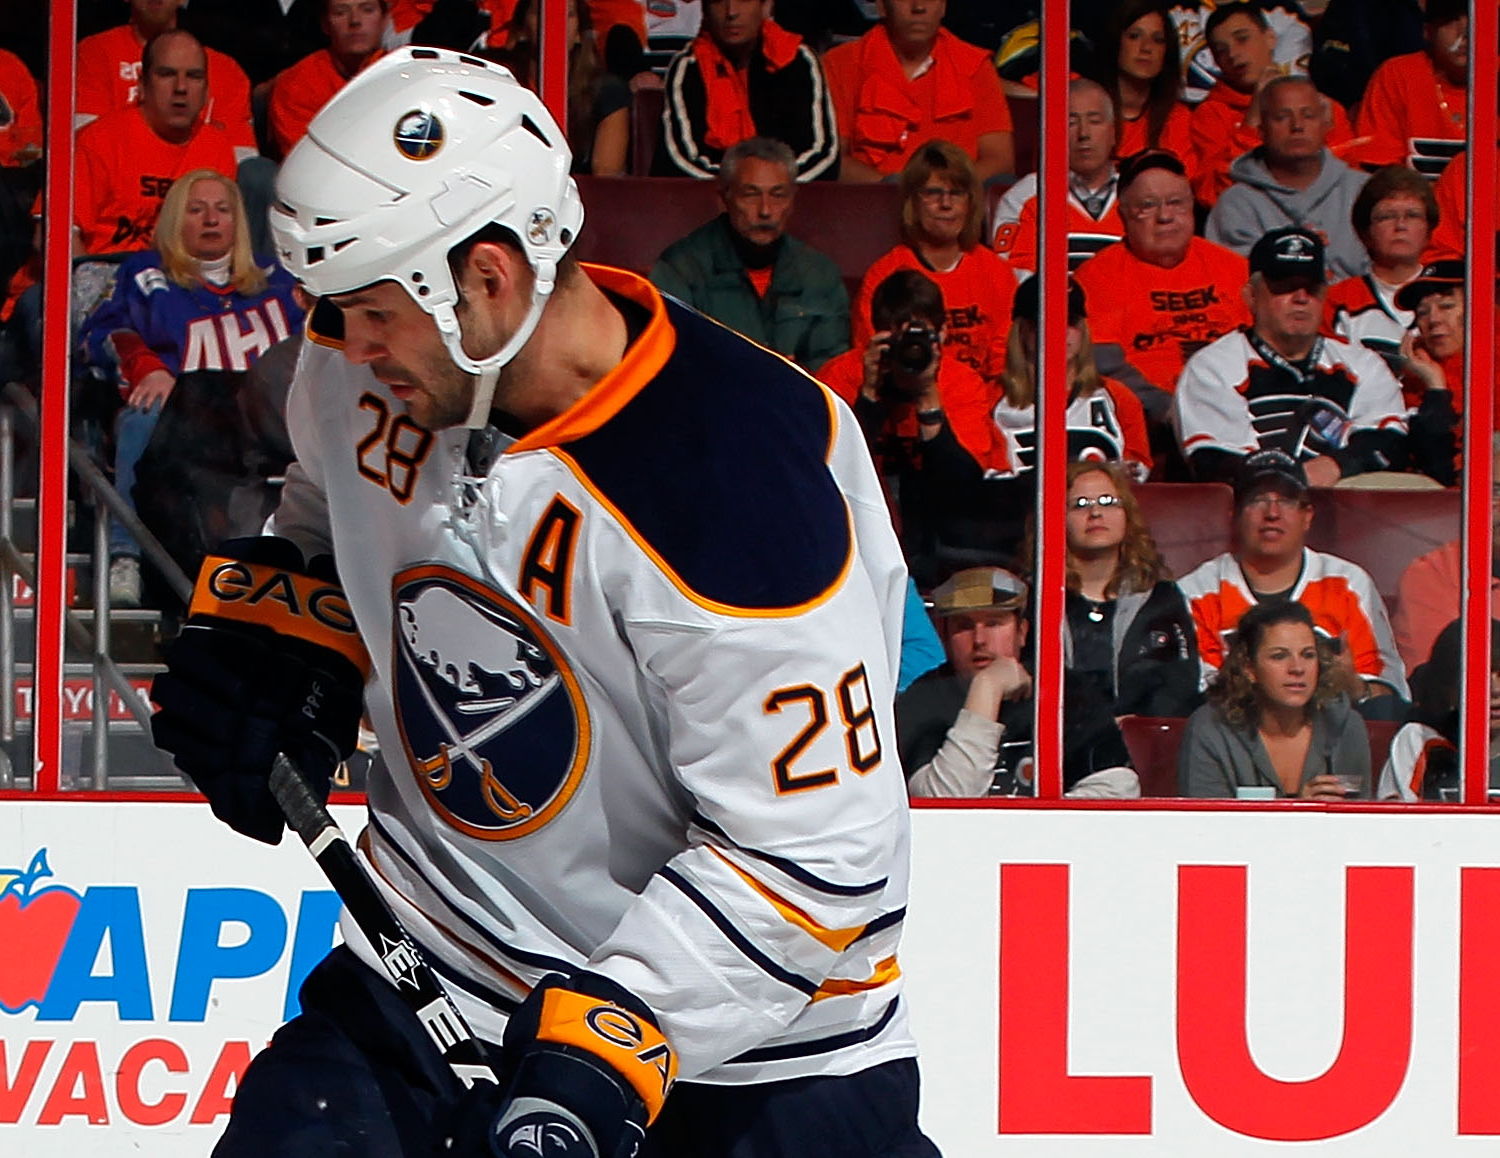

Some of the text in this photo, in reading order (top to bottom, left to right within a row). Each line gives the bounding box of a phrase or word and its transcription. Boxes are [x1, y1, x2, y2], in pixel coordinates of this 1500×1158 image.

[1150, 285, 1219, 312] SEEK
[357, 390, 436, 506] 28
[517, 491, 584, 627] A
[762, 660, 883, 798] 28
